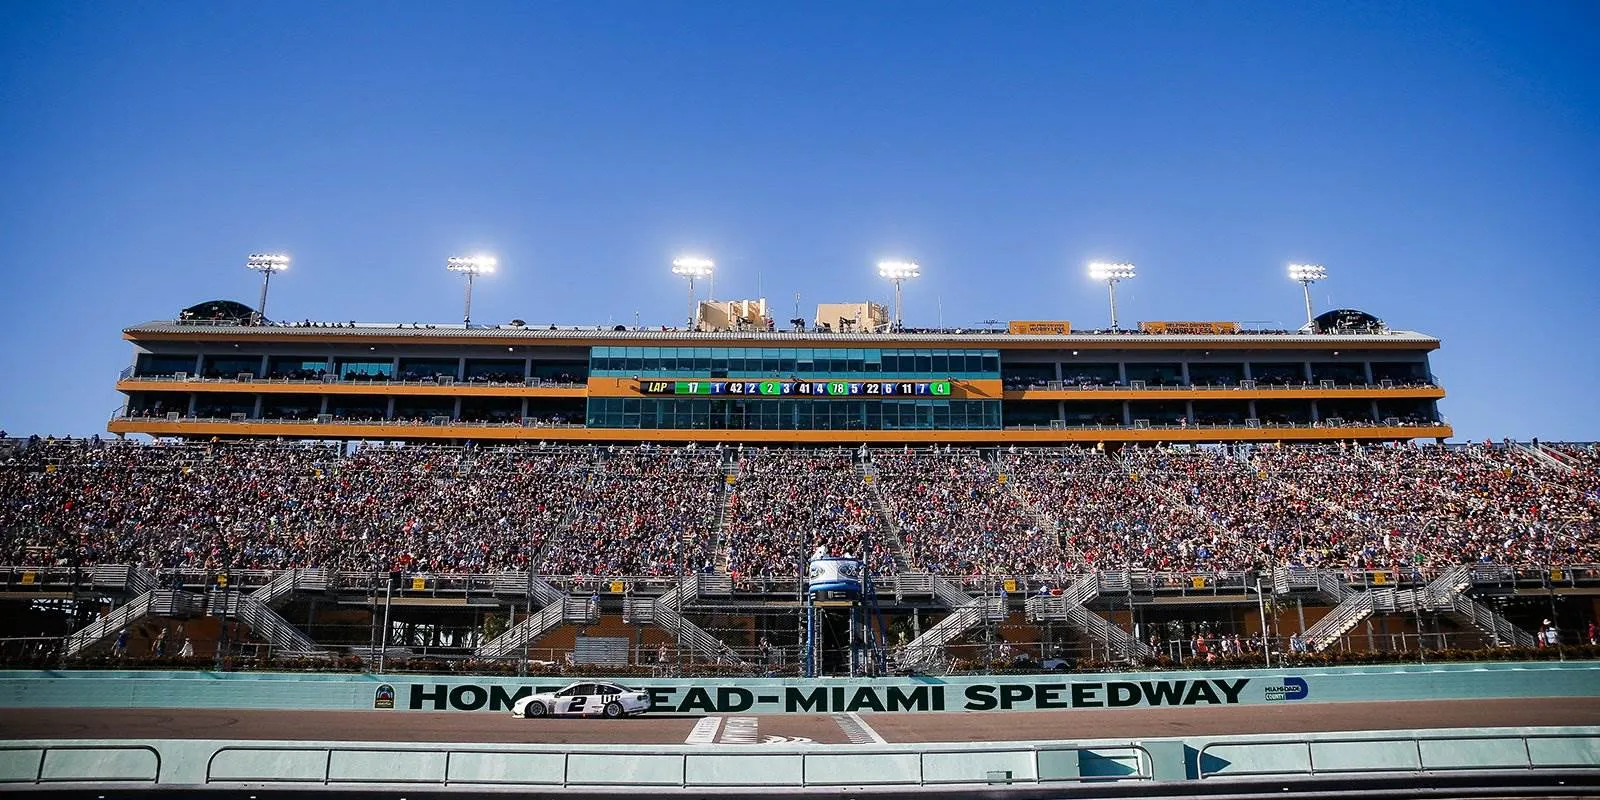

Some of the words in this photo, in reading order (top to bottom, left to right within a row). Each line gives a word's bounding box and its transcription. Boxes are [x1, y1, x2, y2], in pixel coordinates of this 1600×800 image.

[648, 382, 667, 392] LAP
[688, 382, 698, 392] 17
[715, 382, 720, 392] 1
[730, 382, 742, 392] 42
[749, 382, 756, 392] 2
[767, 383, 773, 392] 2
[783, 383, 790, 392] 3
[800, 384, 810, 393] 41
[817, 384, 823, 393] 4
[833, 384, 844, 393] 78
[852, 384, 858, 393] 5
[867, 384, 879, 393] 22
[885, 384, 892, 393] 6
[902, 384, 912, 393] 11
[920, 384, 925, 393] 7
[937, 384, 943, 393] 4
[409, 684, 945, 712] HOMEAD-MIAMI
[964, 678, 1250, 711] SPEEDWAY
[568, 696, 587, 712] 2
